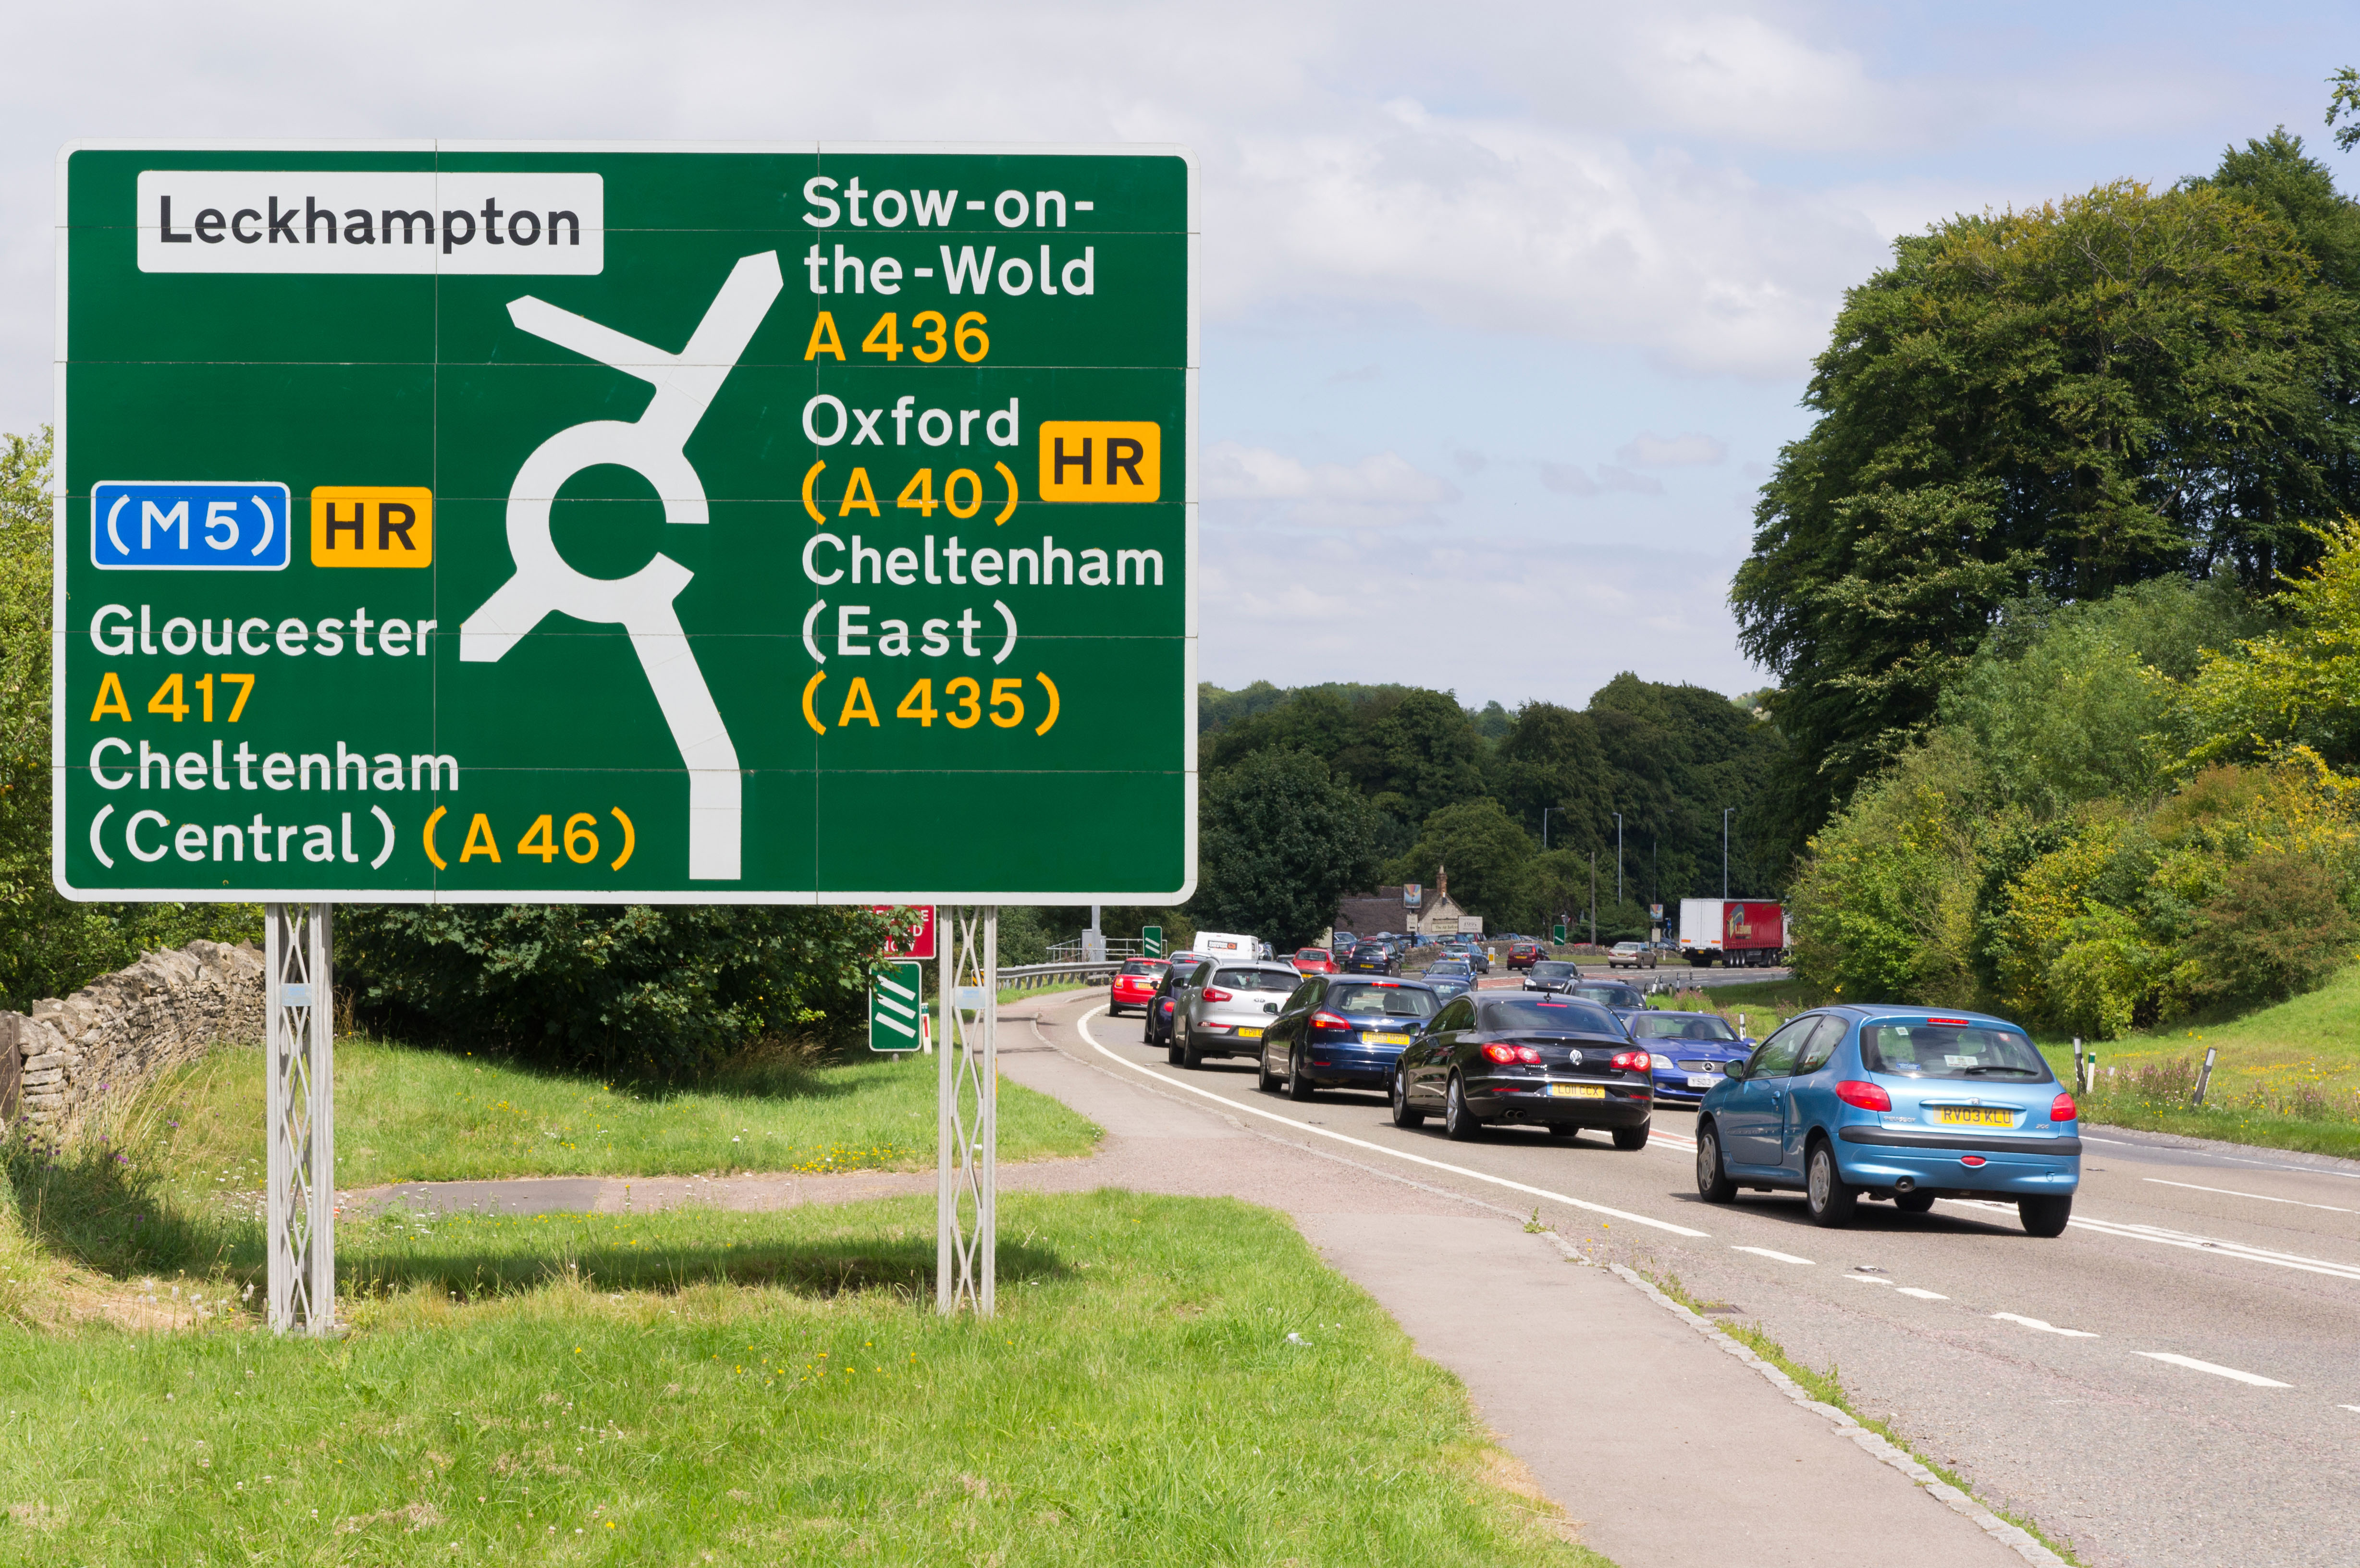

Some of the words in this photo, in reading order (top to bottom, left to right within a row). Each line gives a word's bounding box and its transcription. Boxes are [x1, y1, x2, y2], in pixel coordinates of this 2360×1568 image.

[160, 196, 579, 254] Leckhampton
[802, 176, 1094, 228] Stow-on-
[804, 244, 1094, 295] the-Wold
[802, 394, 1019, 447] Oxford
[1055, 438, 1143, 485] HR
[326, 502, 416, 550] HR
[802, 533, 1163, 586] Cheltenham
[90, 604, 438, 656] Gloucester
[802, 599, 1017, 665] (East)
[89, 737, 458, 791] Cheltenham
[90, 804, 395, 870] (Central)
[1580, 1086, 1599, 1096] CCX
[1943, 1107, 1980, 1122] RV03
[1984, 1109, 2012, 1124] KLU
